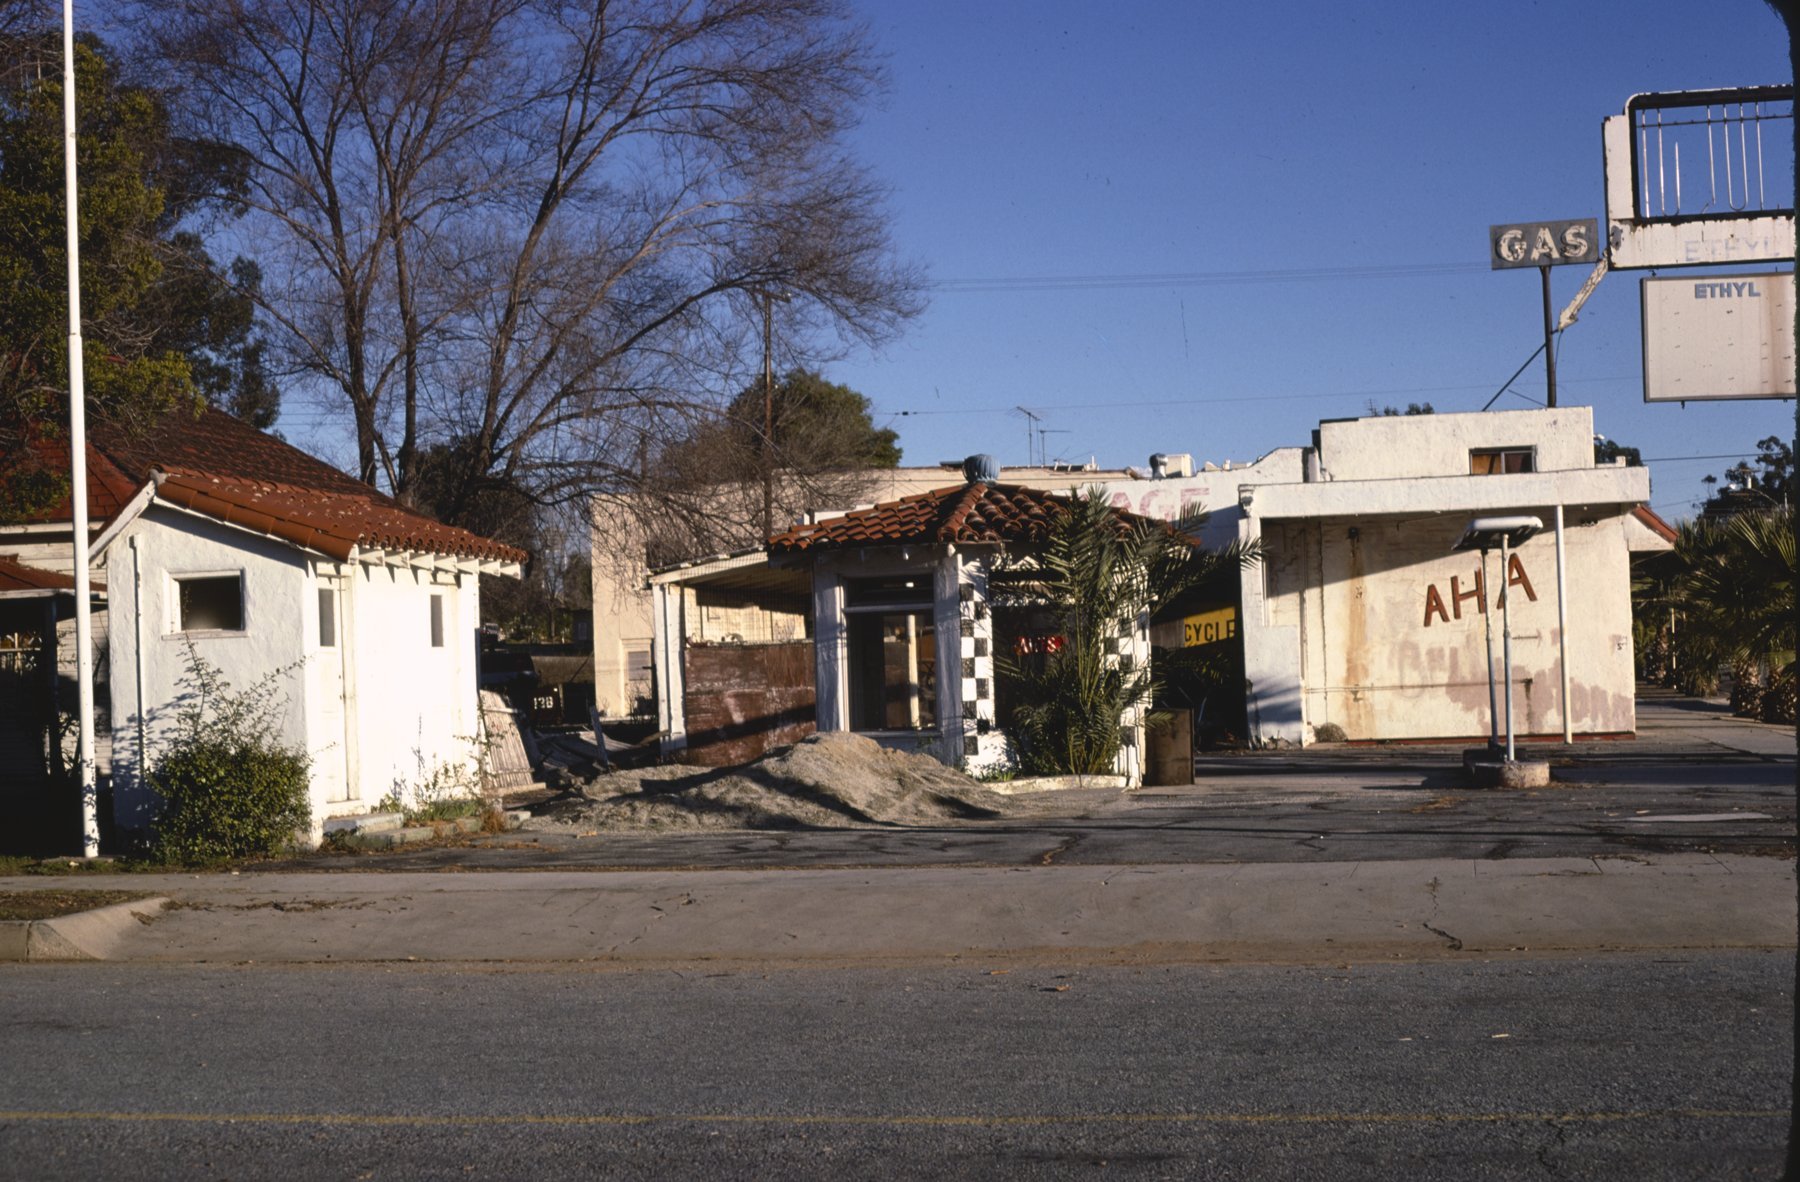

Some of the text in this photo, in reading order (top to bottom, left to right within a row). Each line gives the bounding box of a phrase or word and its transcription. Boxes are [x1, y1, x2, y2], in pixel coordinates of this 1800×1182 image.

[1496, 225, 1590, 262] GAS
[1685, 237, 1780, 261] ETHYL
[1695, 282, 1761, 299] ETHYL
[1423, 552, 1538, 628] AHA
[1184, 619, 1235, 642] CYCLE
